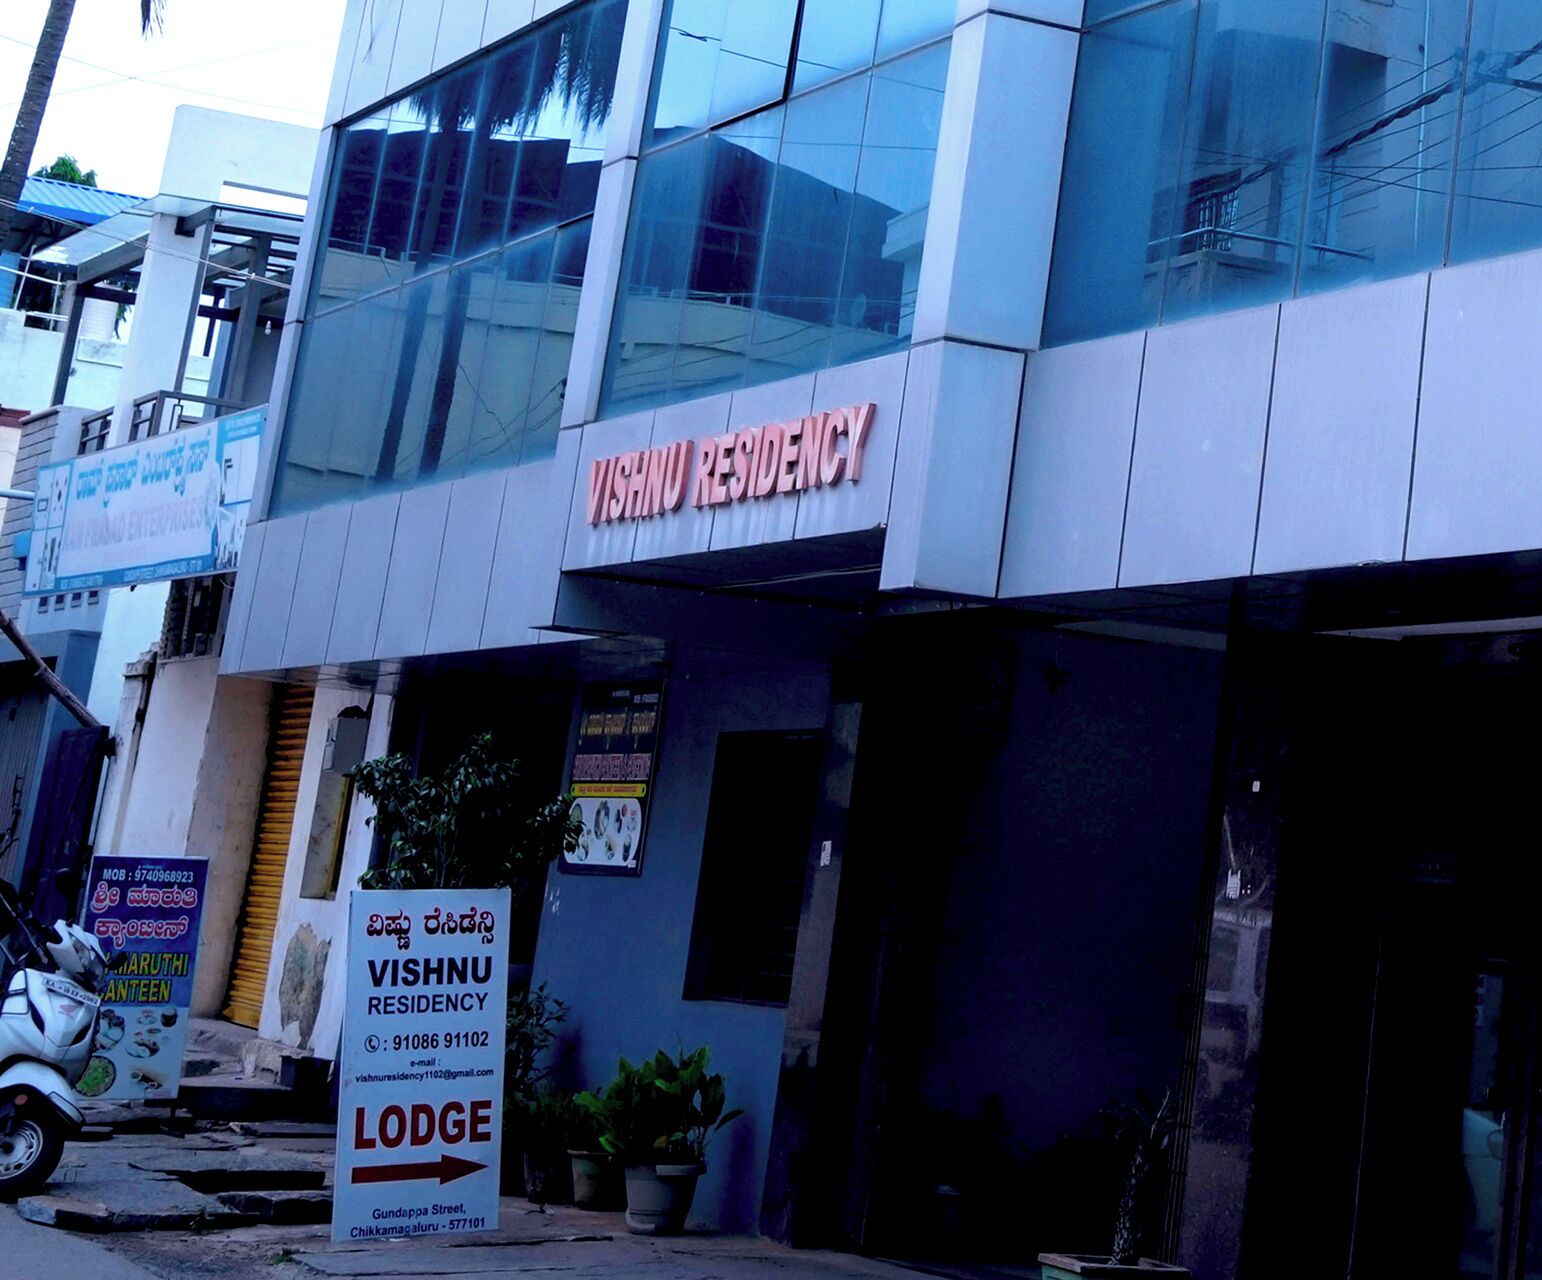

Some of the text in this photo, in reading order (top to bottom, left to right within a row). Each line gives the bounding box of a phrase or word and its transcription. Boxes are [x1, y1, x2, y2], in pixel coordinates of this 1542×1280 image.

[587, 402, 877, 526] VISHNU RESIDENCY
[129, 495, 206, 541] ENTERPRISES
[103, 868, 126, 881] MOB
[134, 869, 194, 883] 9740968923
[367, 955, 493, 988] VISHNU
[367, 991, 490, 1016] RESIDENCY
[392, 1032, 440, 1052] 91086
[443, 1030, 490, 1049] 91102
[410, 1057, 436, 1068] e-mail
[355, 1067, 495, 1084] vishnuresidency1102@gmail.com
[354, 1099, 493, 1151] LODGE
[371, 1202, 467, 1221] Gundappa Street,
[350, 1221, 440, 1239] Chikkamagaluru
[449, 1217, 486, 1230] 577101
